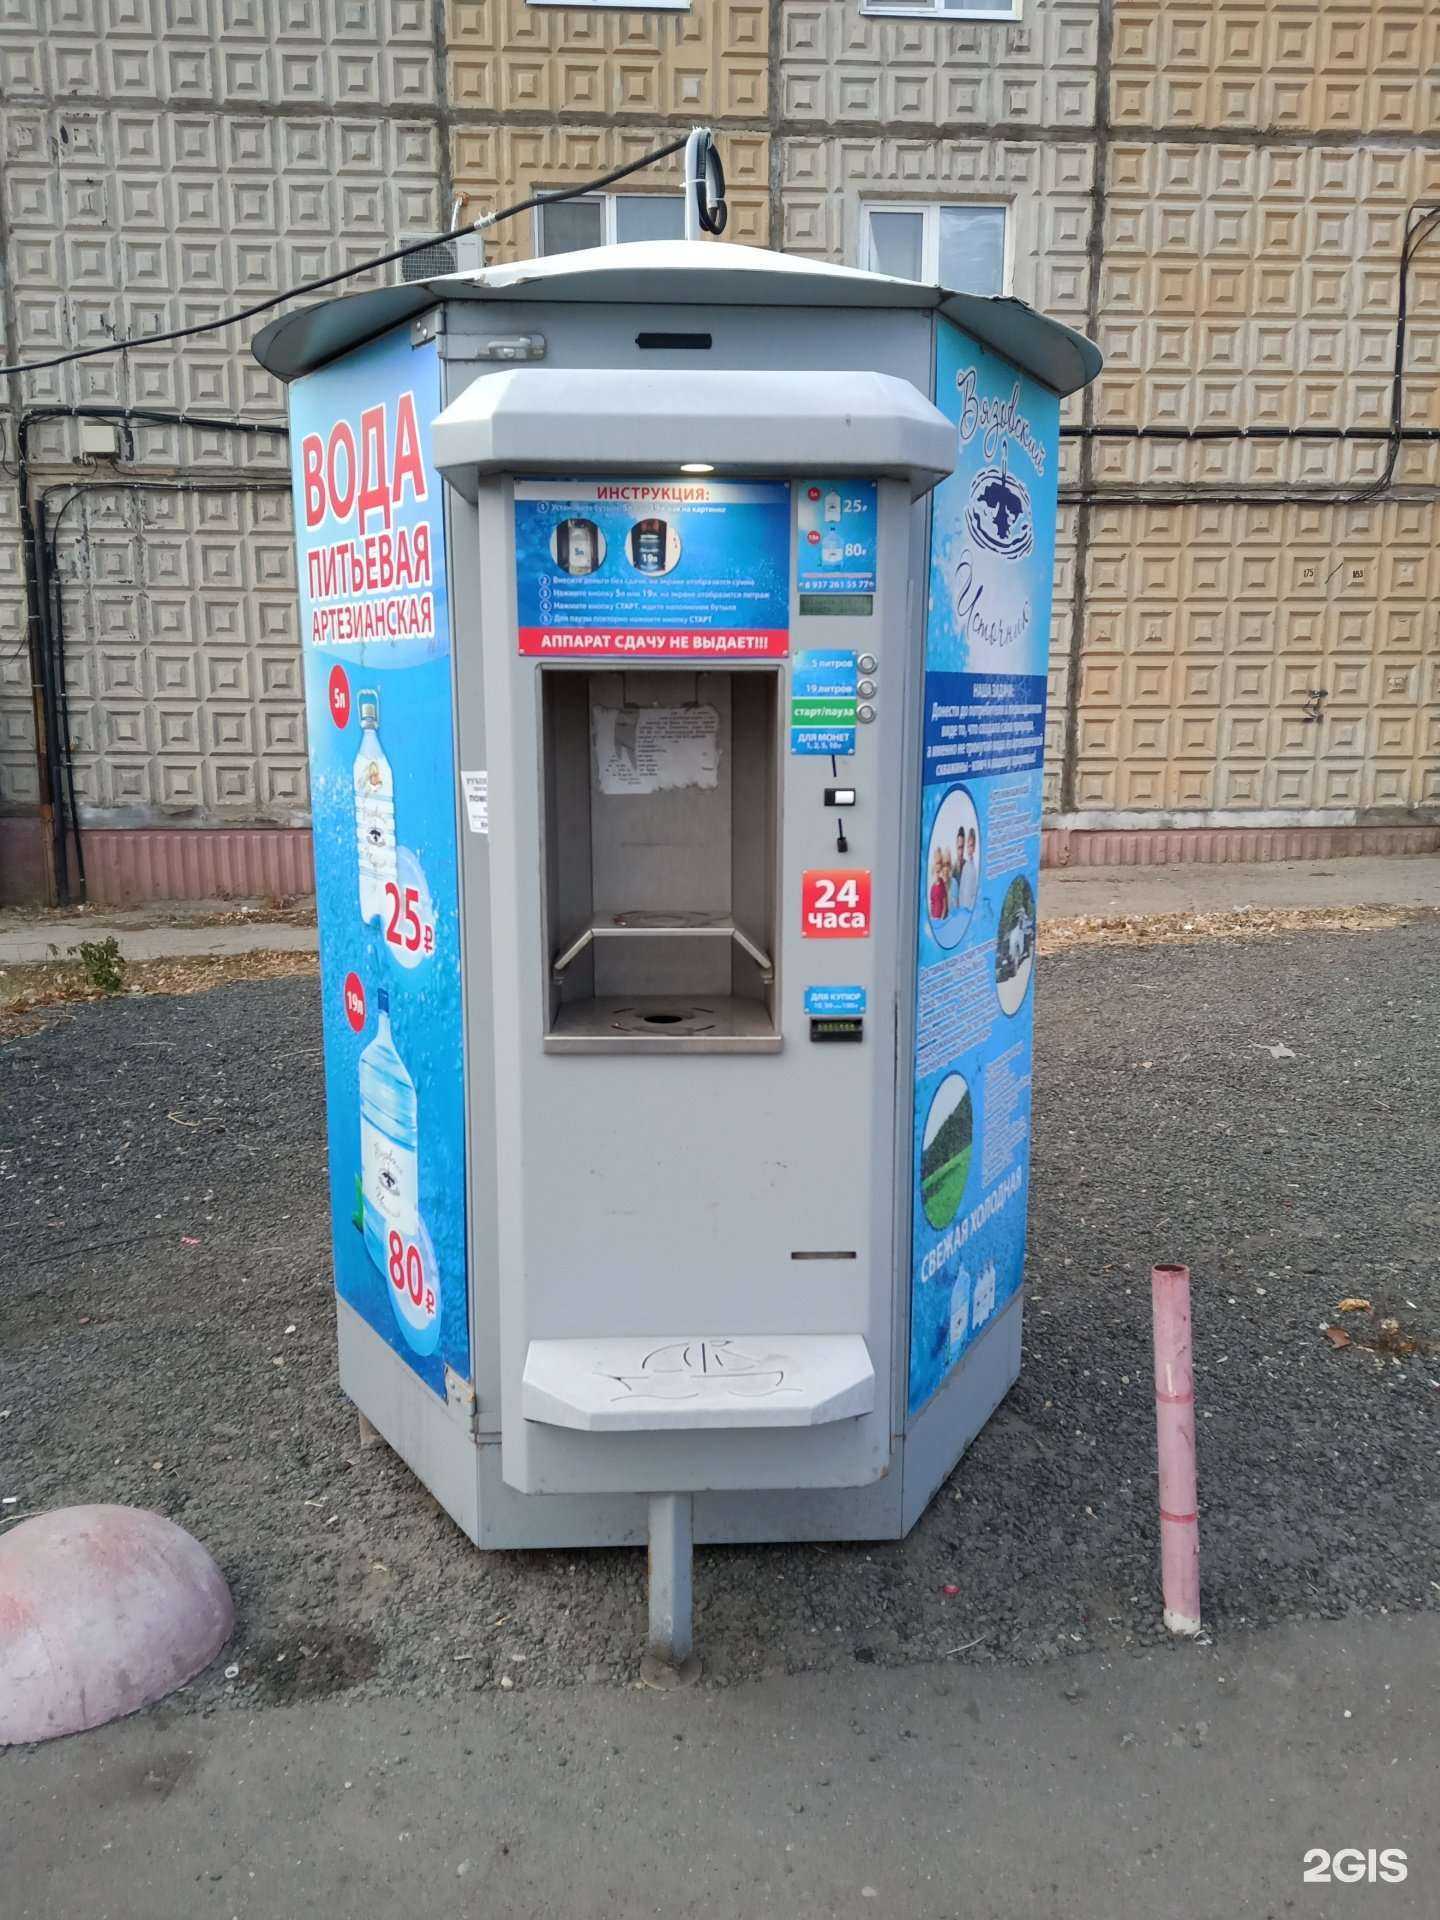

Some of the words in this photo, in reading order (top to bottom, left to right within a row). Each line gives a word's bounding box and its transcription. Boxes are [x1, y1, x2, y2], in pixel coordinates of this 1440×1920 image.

[302, 390, 427, 536] ВОДА
[597, 487, 710, 502] ИНСТРУКЦИЯ:
[307, 524, 431, 600] ПИТЬЕВАЯ
[312, 596, 433, 642] АРТЕЗИАНСКАЯ
[689, 615, 713, 624] СТАРТ
[541, 634, 611, 649] АППАРАТ
[613, 635, 666, 651] СДАЧУ
[669, 635, 689, 649] НЕ
[693, 635, 769, 651] ВЫДАЕТ!!!
[811, 659, 817, 668] 5
[819, 660, 854, 669] литров
[806, 684, 817, 693] 19
[819, 685, 853, 694] литров
[334, 687, 346, 710] 5л
[794, 706, 855, 719] старт/пауза
[798, 733, 818, 742] ДЛЯ
[819, 733, 849, 742] МОНЕТ
[813, 879, 860, 909] 24
[808, 911, 866, 929] часа
[345, 990, 364, 1016] 19л
[811, 992, 829, 1002] ДЛЯ
[830, 992, 862, 1001] КУПЮР
[921, 1218, 969, 1284] СВЕЖАЯ
[970, 1163, 1022, 1236] ХОЛОДНАЯ
